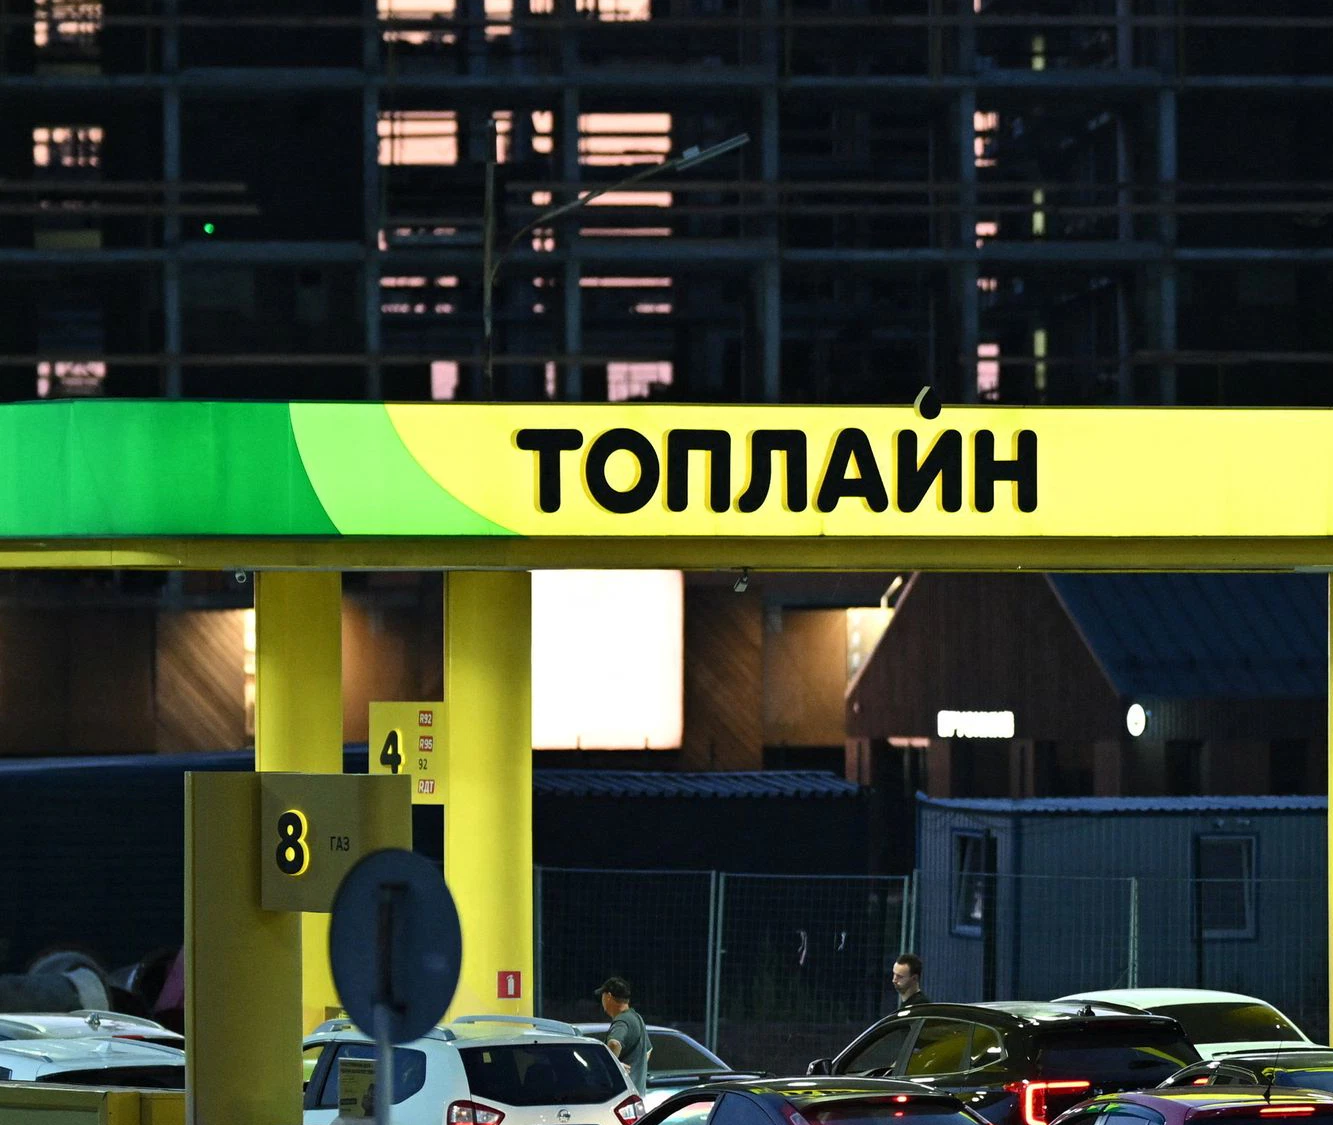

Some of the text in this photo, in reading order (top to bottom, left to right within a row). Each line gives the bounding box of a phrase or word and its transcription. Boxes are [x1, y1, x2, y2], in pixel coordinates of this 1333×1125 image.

[512, 388, 1038, 514] ТОПЛАЙН
[420, 713, 432, 724] R92
[420, 738, 432, 749] R95
[380, 730, 402, 774] 4
[419, 758, 428, 770] 92
[276, 811, 307, 874] 8
[330, 836, 350, 851] ГАЗ
